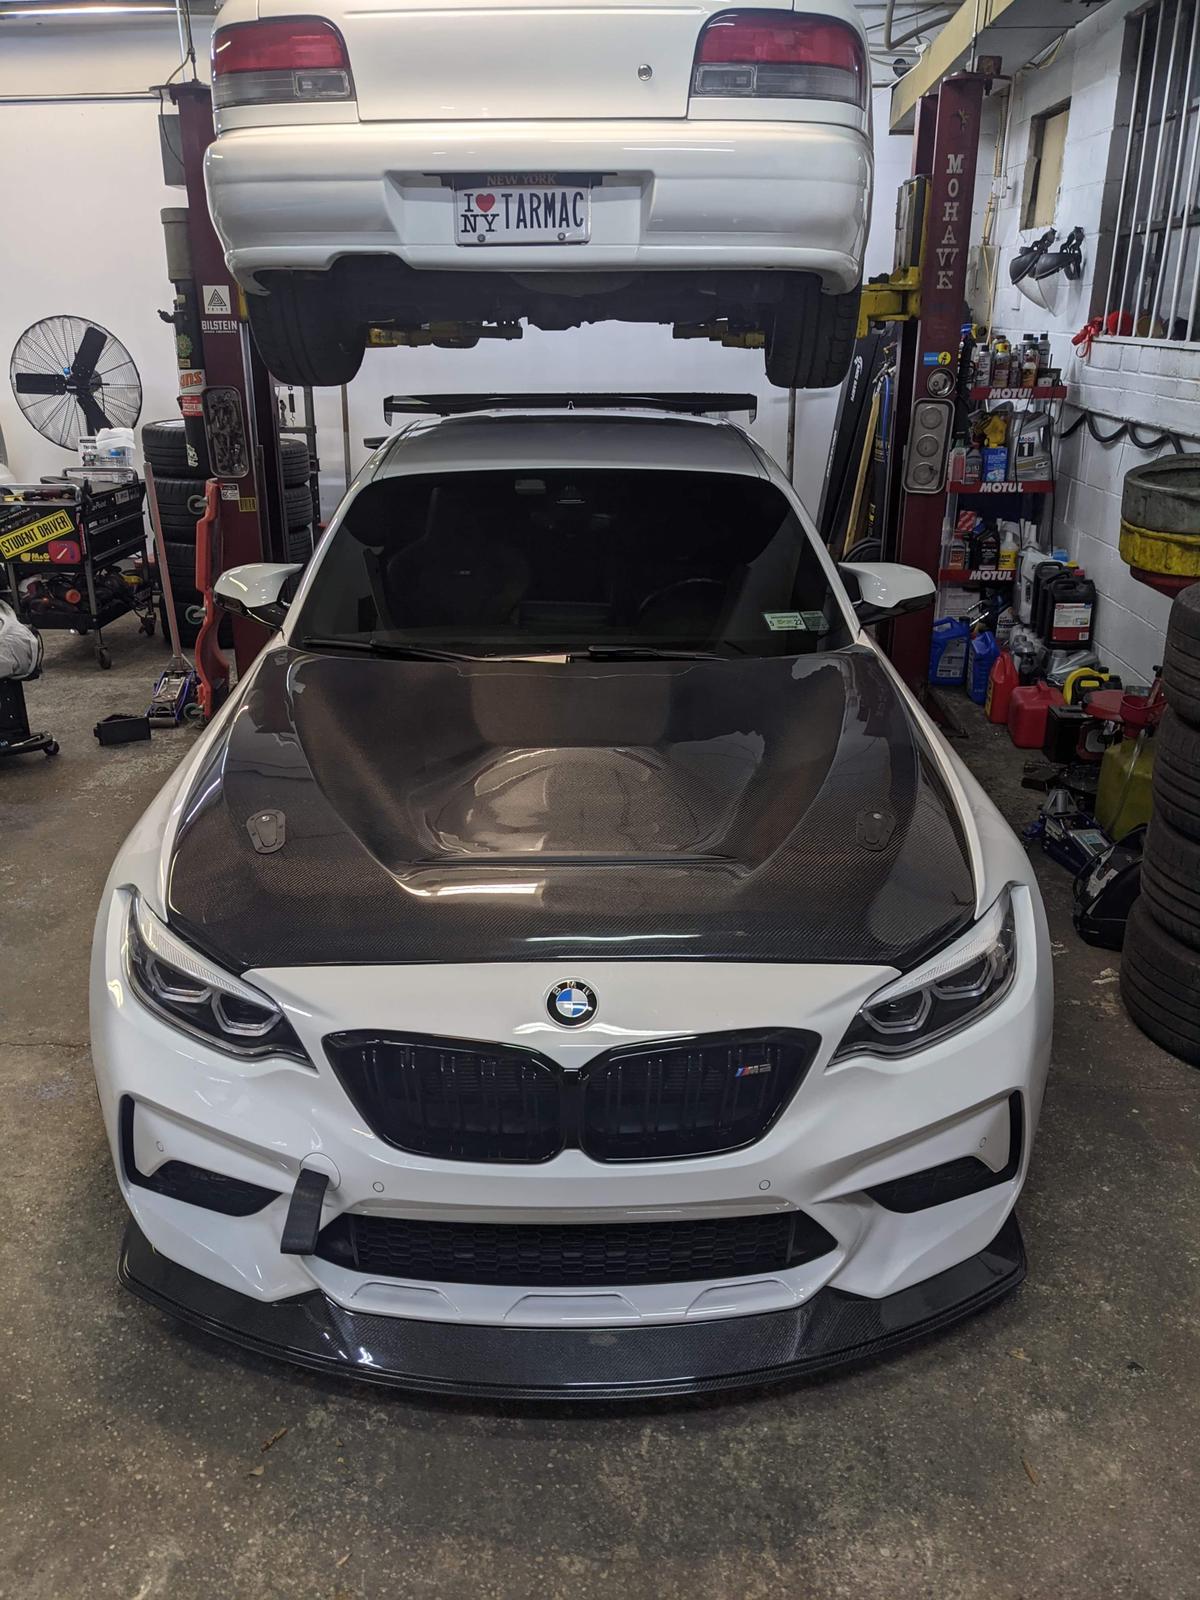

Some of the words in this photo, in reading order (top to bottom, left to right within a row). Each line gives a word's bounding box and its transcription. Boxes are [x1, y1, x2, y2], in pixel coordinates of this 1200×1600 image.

[487, 174, 518, 186] NEW
[521, 173, 557, 186] YORK
[464, 193, 474, 213] I
[501, 191, 584, 229] TARMAC
[460, 213, 500, 233] NY
[936, 153, 964, 290] MOHAWK
[201, 320, 238, 330] BILSTEIN
[988, 388, 1034, 399] MOTUL
[979, 482, 1024, 493] MOTUL
[1, 528, 39, 553] STUDENT
[37, 515, 70, 538] DRIVER
[969, 570, 1013, 581] MOTUL
[552, 980, 593, 997] BMW
